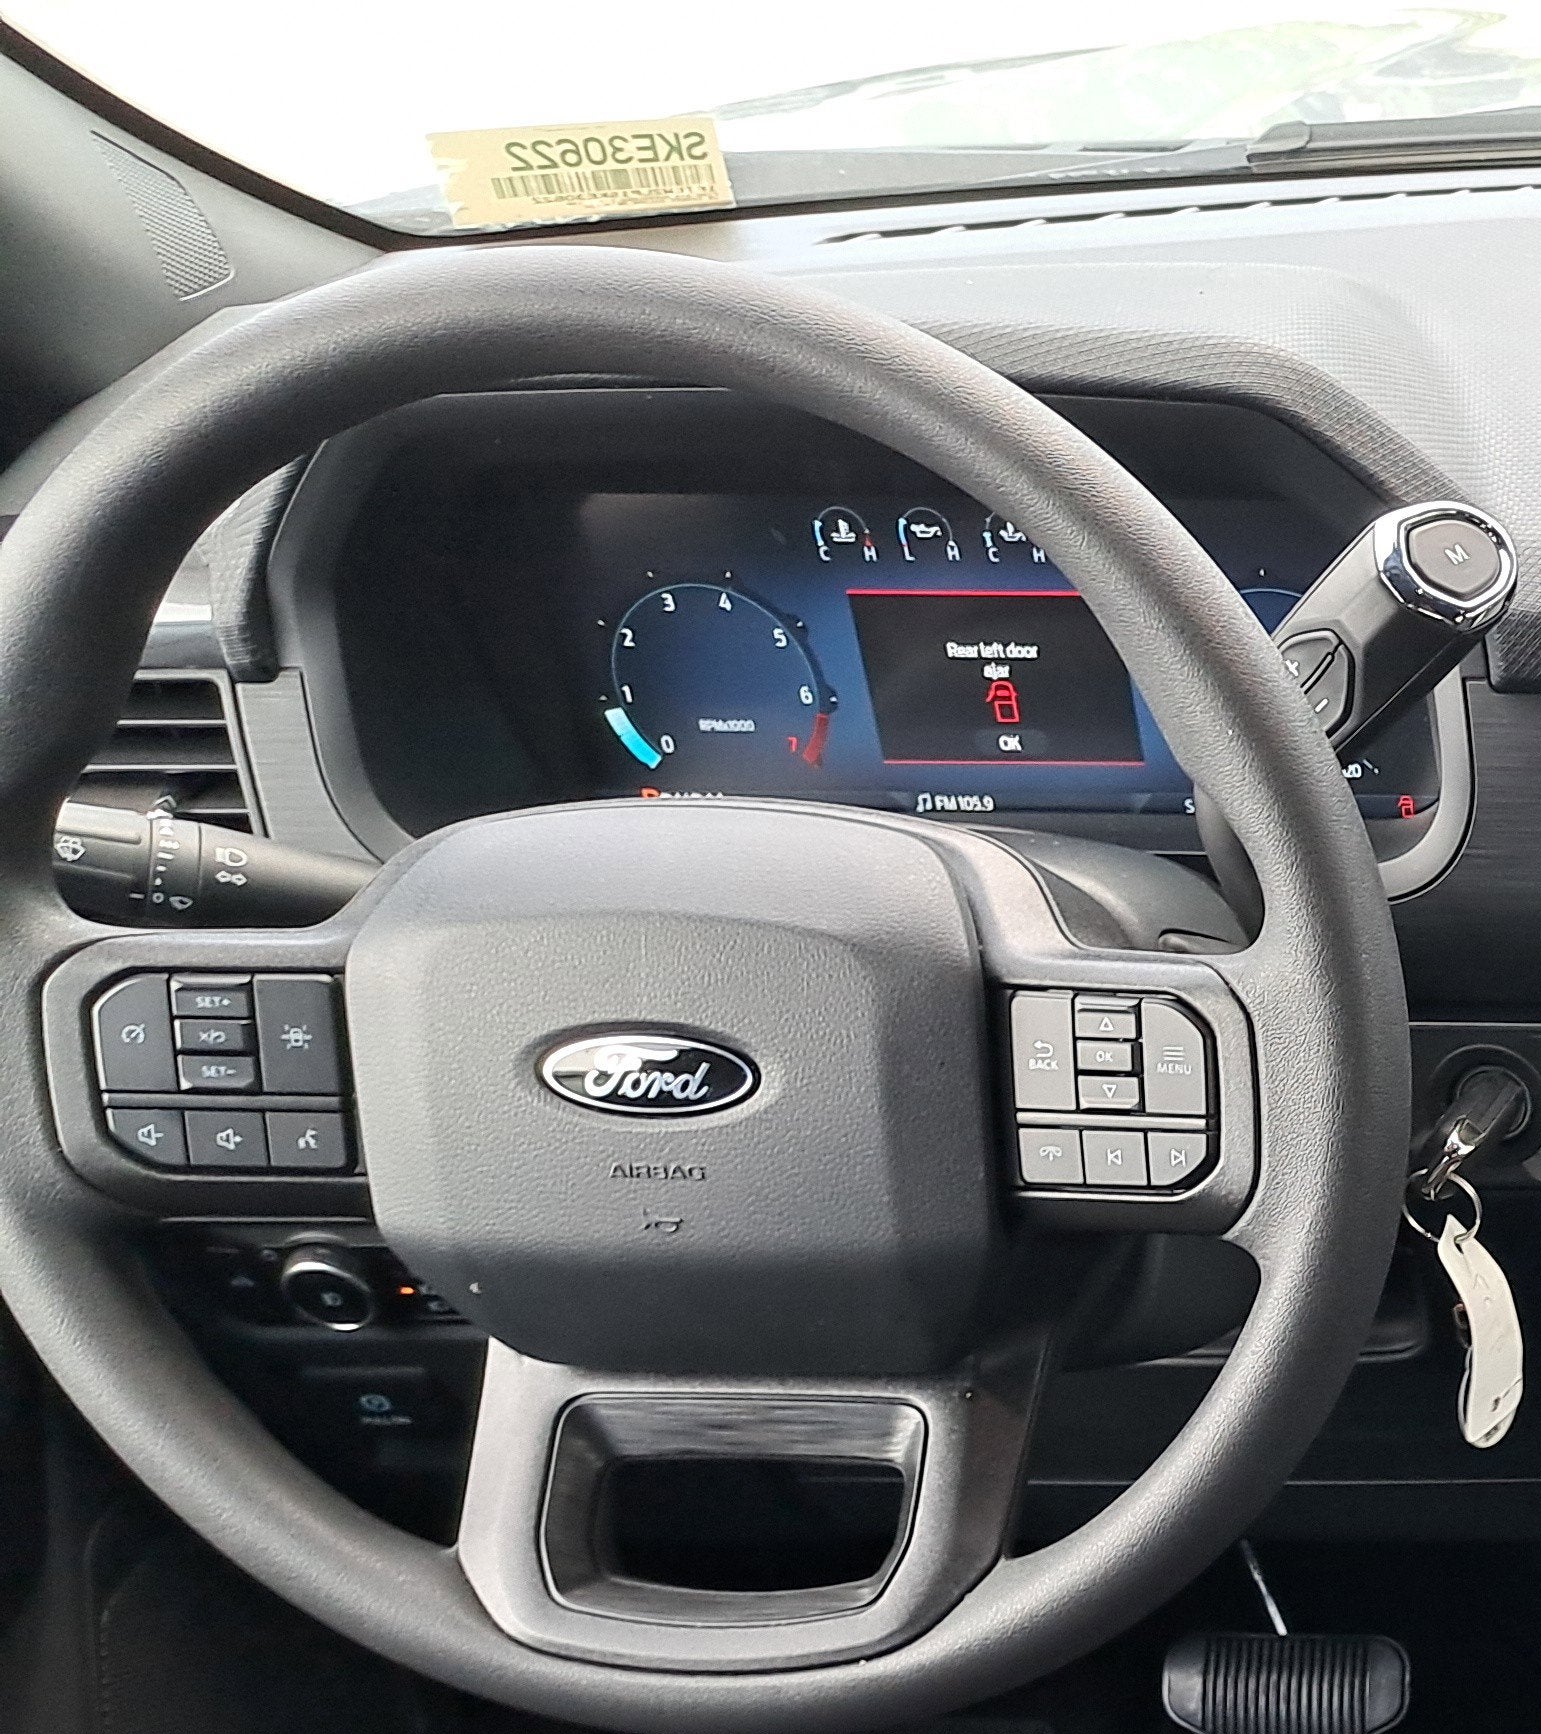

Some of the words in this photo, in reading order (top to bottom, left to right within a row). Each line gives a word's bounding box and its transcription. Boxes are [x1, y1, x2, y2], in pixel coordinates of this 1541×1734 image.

[819, 546, 831, 561] C
[863, 546, 878, 562] H
[903, 546, 916, 561] L
[946, 545, 961, 561] H
[988, 546, 1000, 562] C
[1032, 547, 1047, 562] H
[1444, 543, 1470, 566] M
[661, 592, 675, 612] 3
[718, 592, 732, 612] 4
[619, 628, 635, 648] 2
[773, 628, 788, 648] 5
[946, 642, 979, 659] Rear
[980, 642, 1005, 659] left
[1006, 642, 1039, 659] door
[622, 685, 633, 704] 1
[799, 686, 813, 706] 6
[660, 735, 675, 754] 0
[999, 735, 1022, 751] OK
[935, 795, 957, 811] FM
[958, 795, 994, 812] 105.9
[1028, 1058, 1059, 1071] BACK
[1096, 1049, 1114, 1063] OK
[583, 1045, 712, 1100] Ford
[1156, 1062, 1193, 1075] MENU
[609, 1162, 707, 1181] AIRBAG
